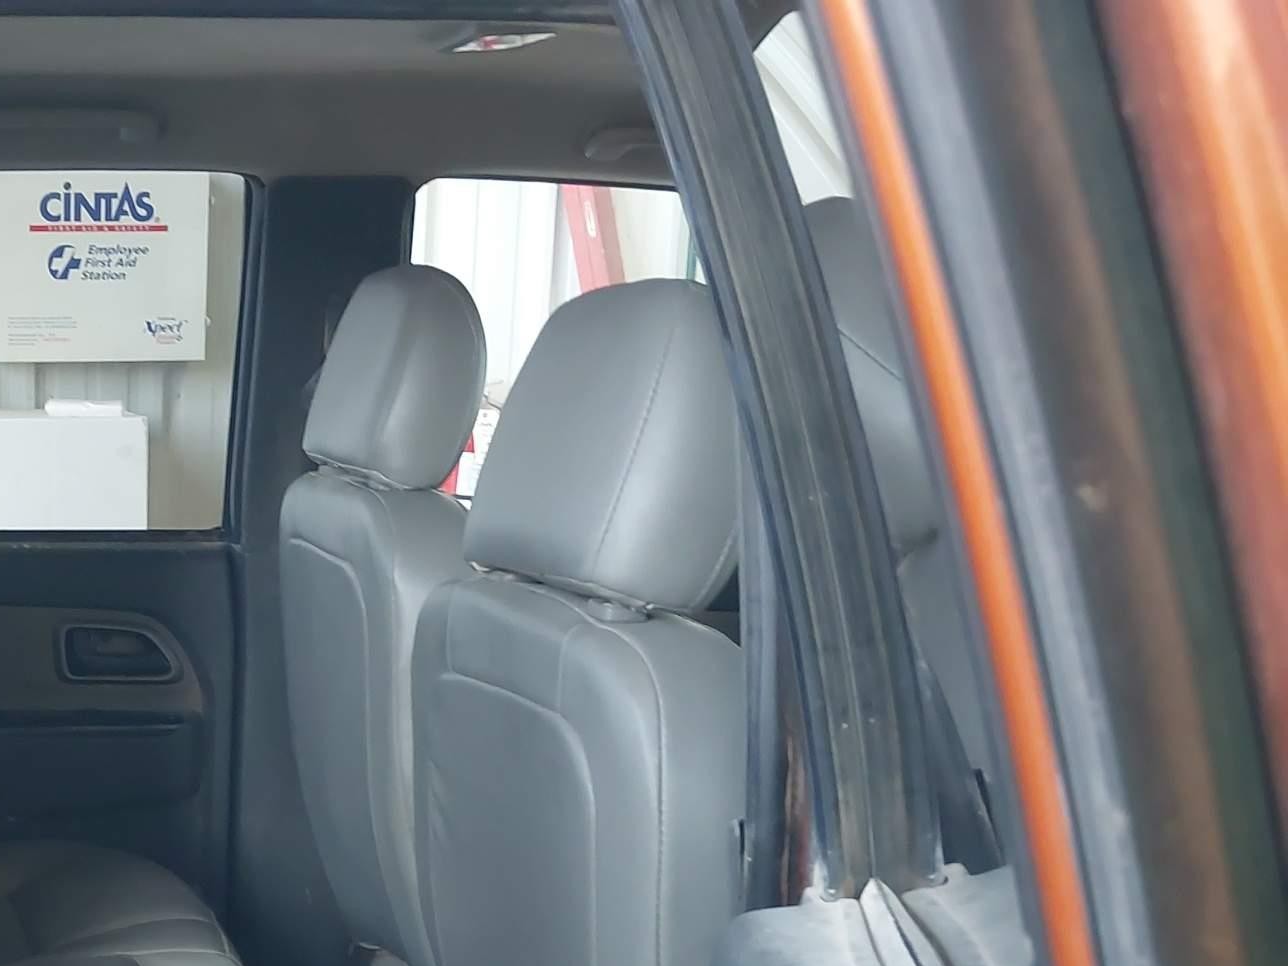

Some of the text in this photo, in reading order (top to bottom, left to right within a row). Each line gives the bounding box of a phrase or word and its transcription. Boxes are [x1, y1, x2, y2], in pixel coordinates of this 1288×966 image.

[87, 244, 150, 257] Employee
[84, 257, 138, 268] First Aid
[80, 270, 127, 281] Station
